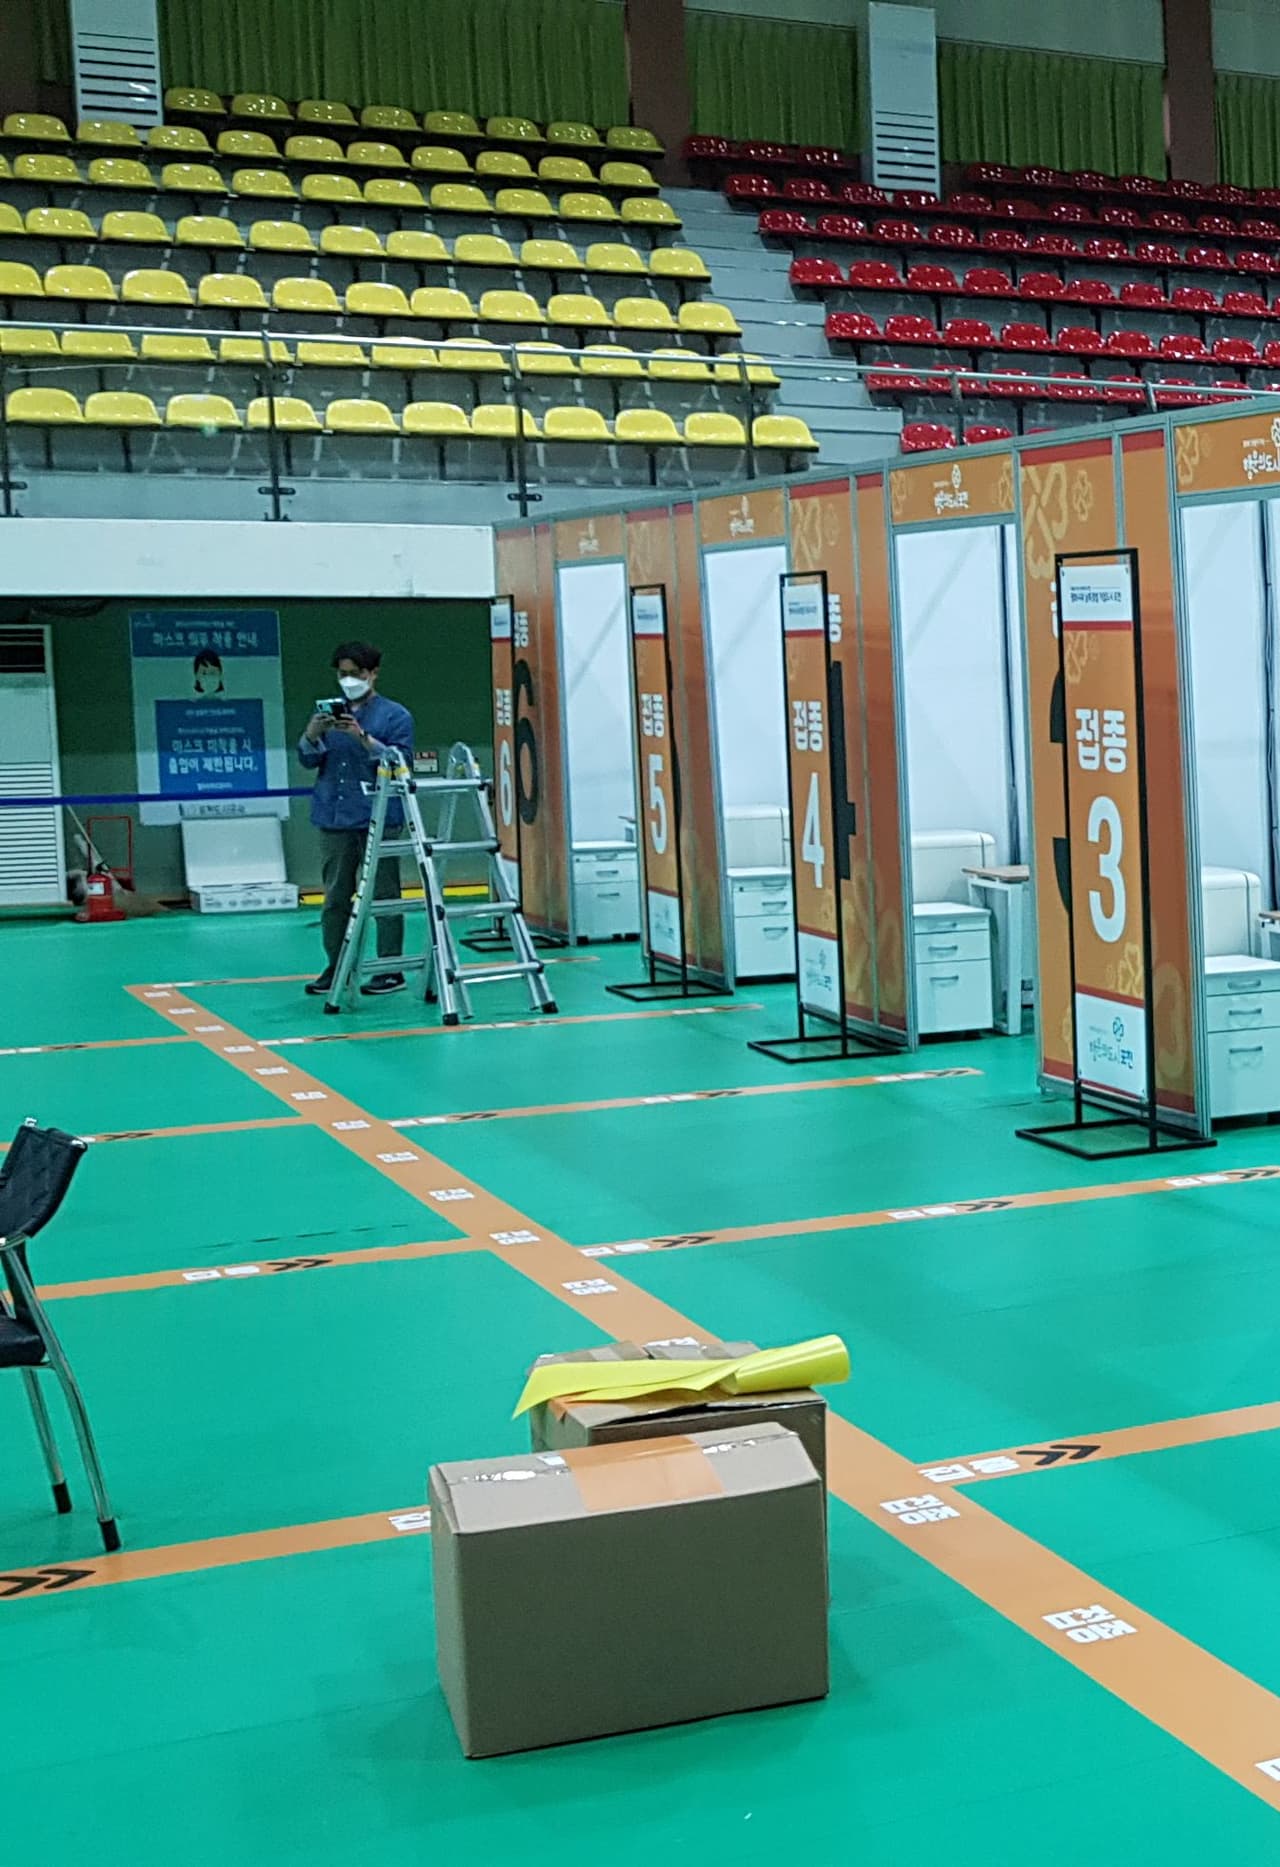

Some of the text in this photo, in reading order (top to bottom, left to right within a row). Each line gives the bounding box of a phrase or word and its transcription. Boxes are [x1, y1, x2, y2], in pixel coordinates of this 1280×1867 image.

[514, 659, 539, 825] 6
[792, 700, 824, 752] 접종
[1075, 708, 1127, 773] 접종
[500, 739, 513, 826] 6
[649, 754, 667, 854] 5
[802, 772, 825, 888] 4
[1087, 796, 1126, 943] 3
[1041, 1604, 1138, 1644] 접종
